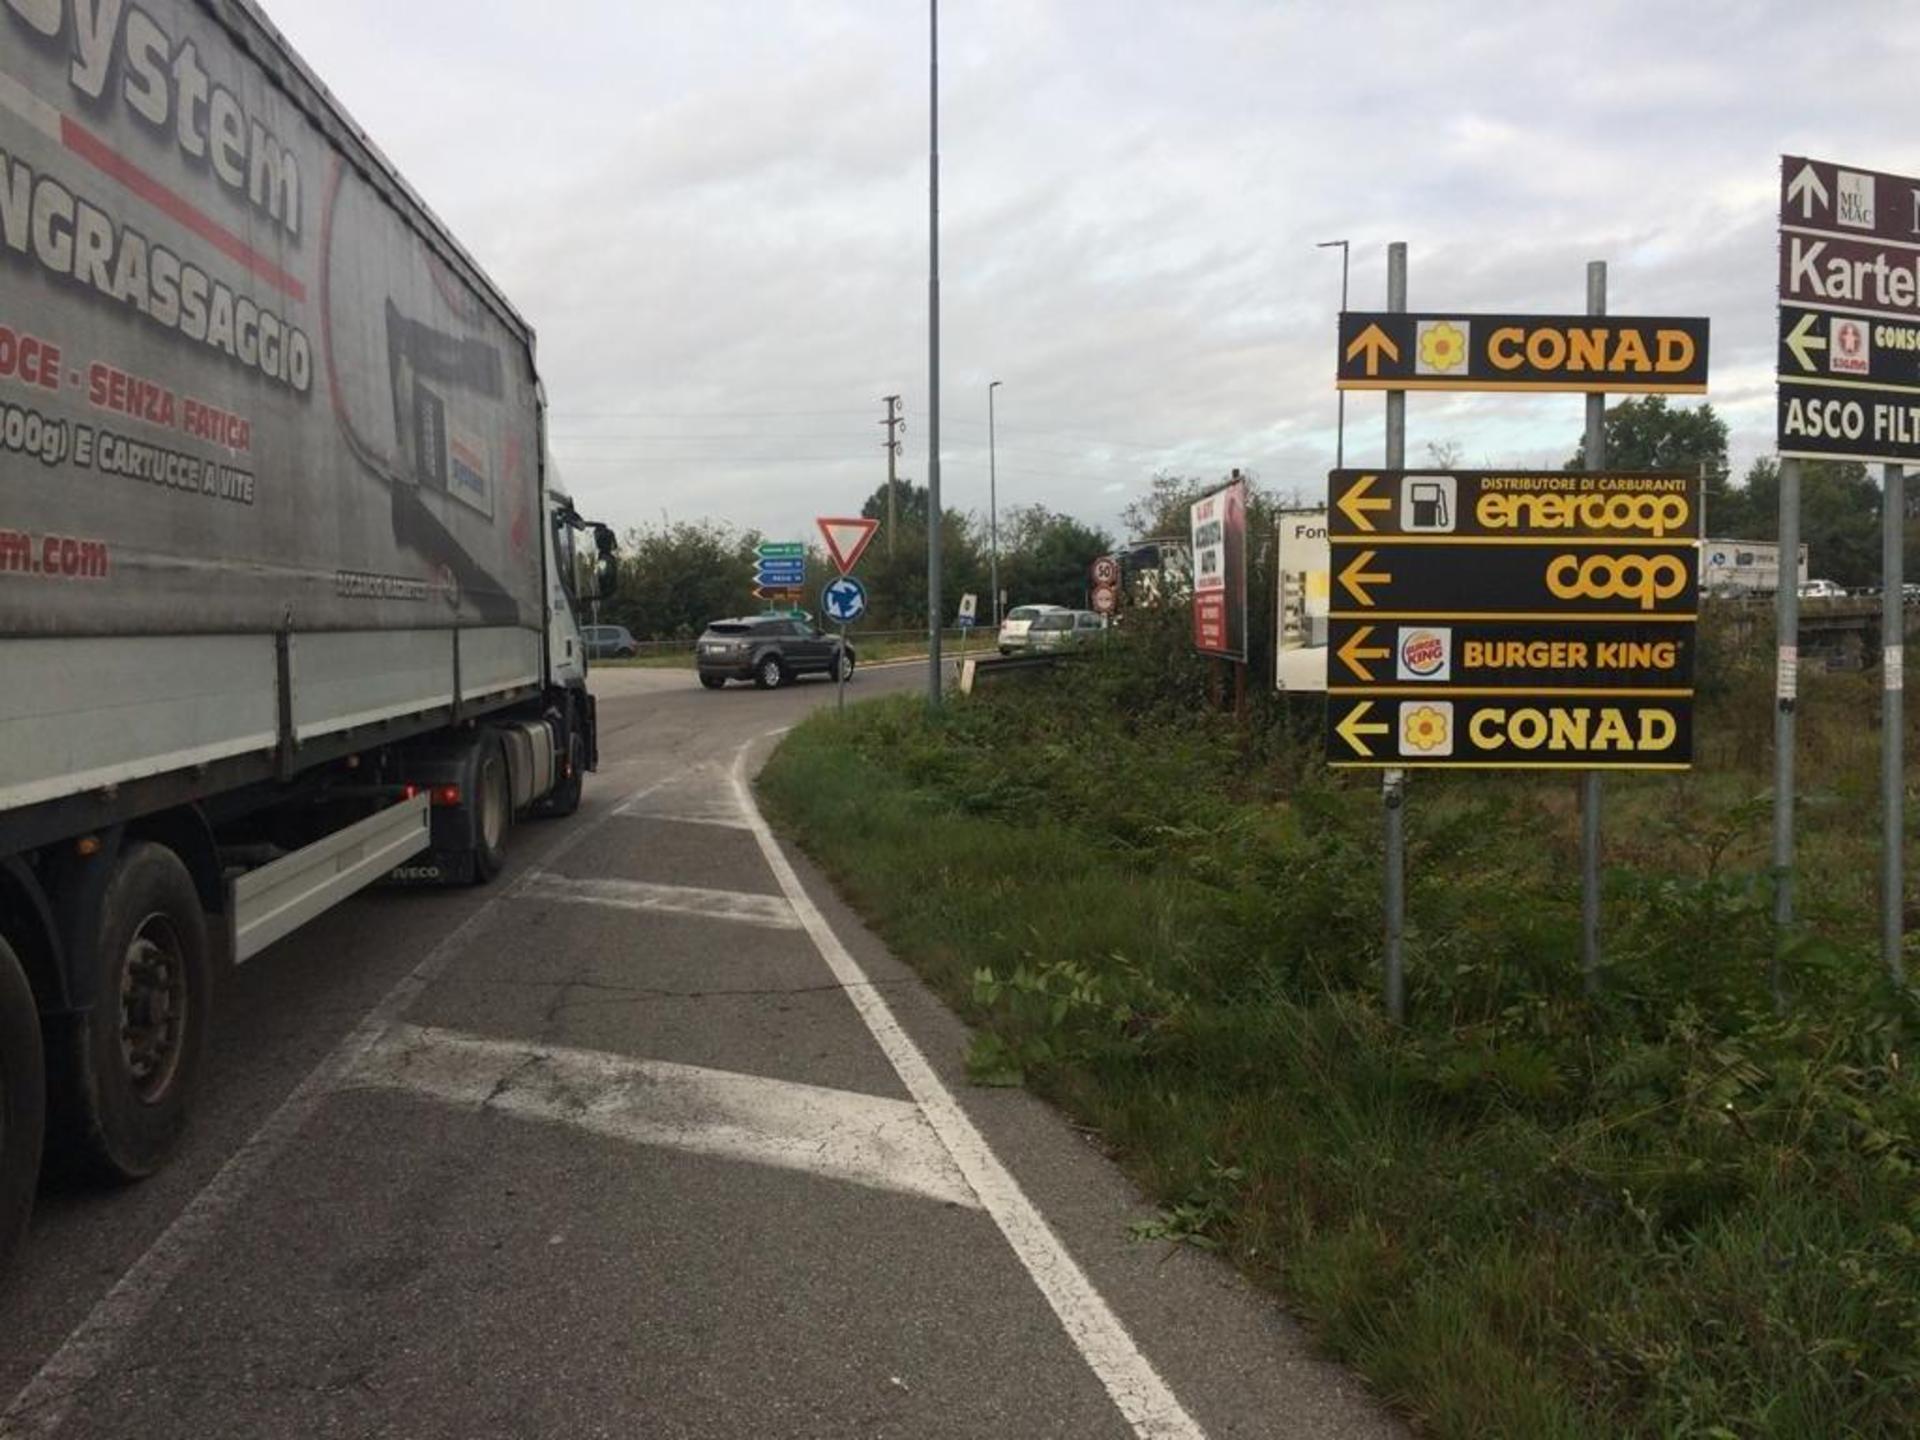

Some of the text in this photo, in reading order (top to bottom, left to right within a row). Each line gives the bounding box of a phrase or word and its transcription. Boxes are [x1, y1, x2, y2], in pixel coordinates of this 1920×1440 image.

[1487, 327, 1695, 373] CONAD
[88, 363, 176, 428] SENZA
[182, 398, 250, 450] FATICA
[1784, 397, 1865, 440] ASCO
[0, 401, 255, 504] 00g) E CARTUCCE A VITE
[1481, 477, 1686, 492] DISTRIBUTORE DI CARBURANTI
[1477, 492, 1689, 537] enercoop
[1098, 564, 1111, 578] 50
[1546, 554, 1687, 610] coop
[1463, 641, 1677, 669] BURGER KING
[1469, 708, 1677, 750] CONAD
[393, 866, 439, 878] IVECO
